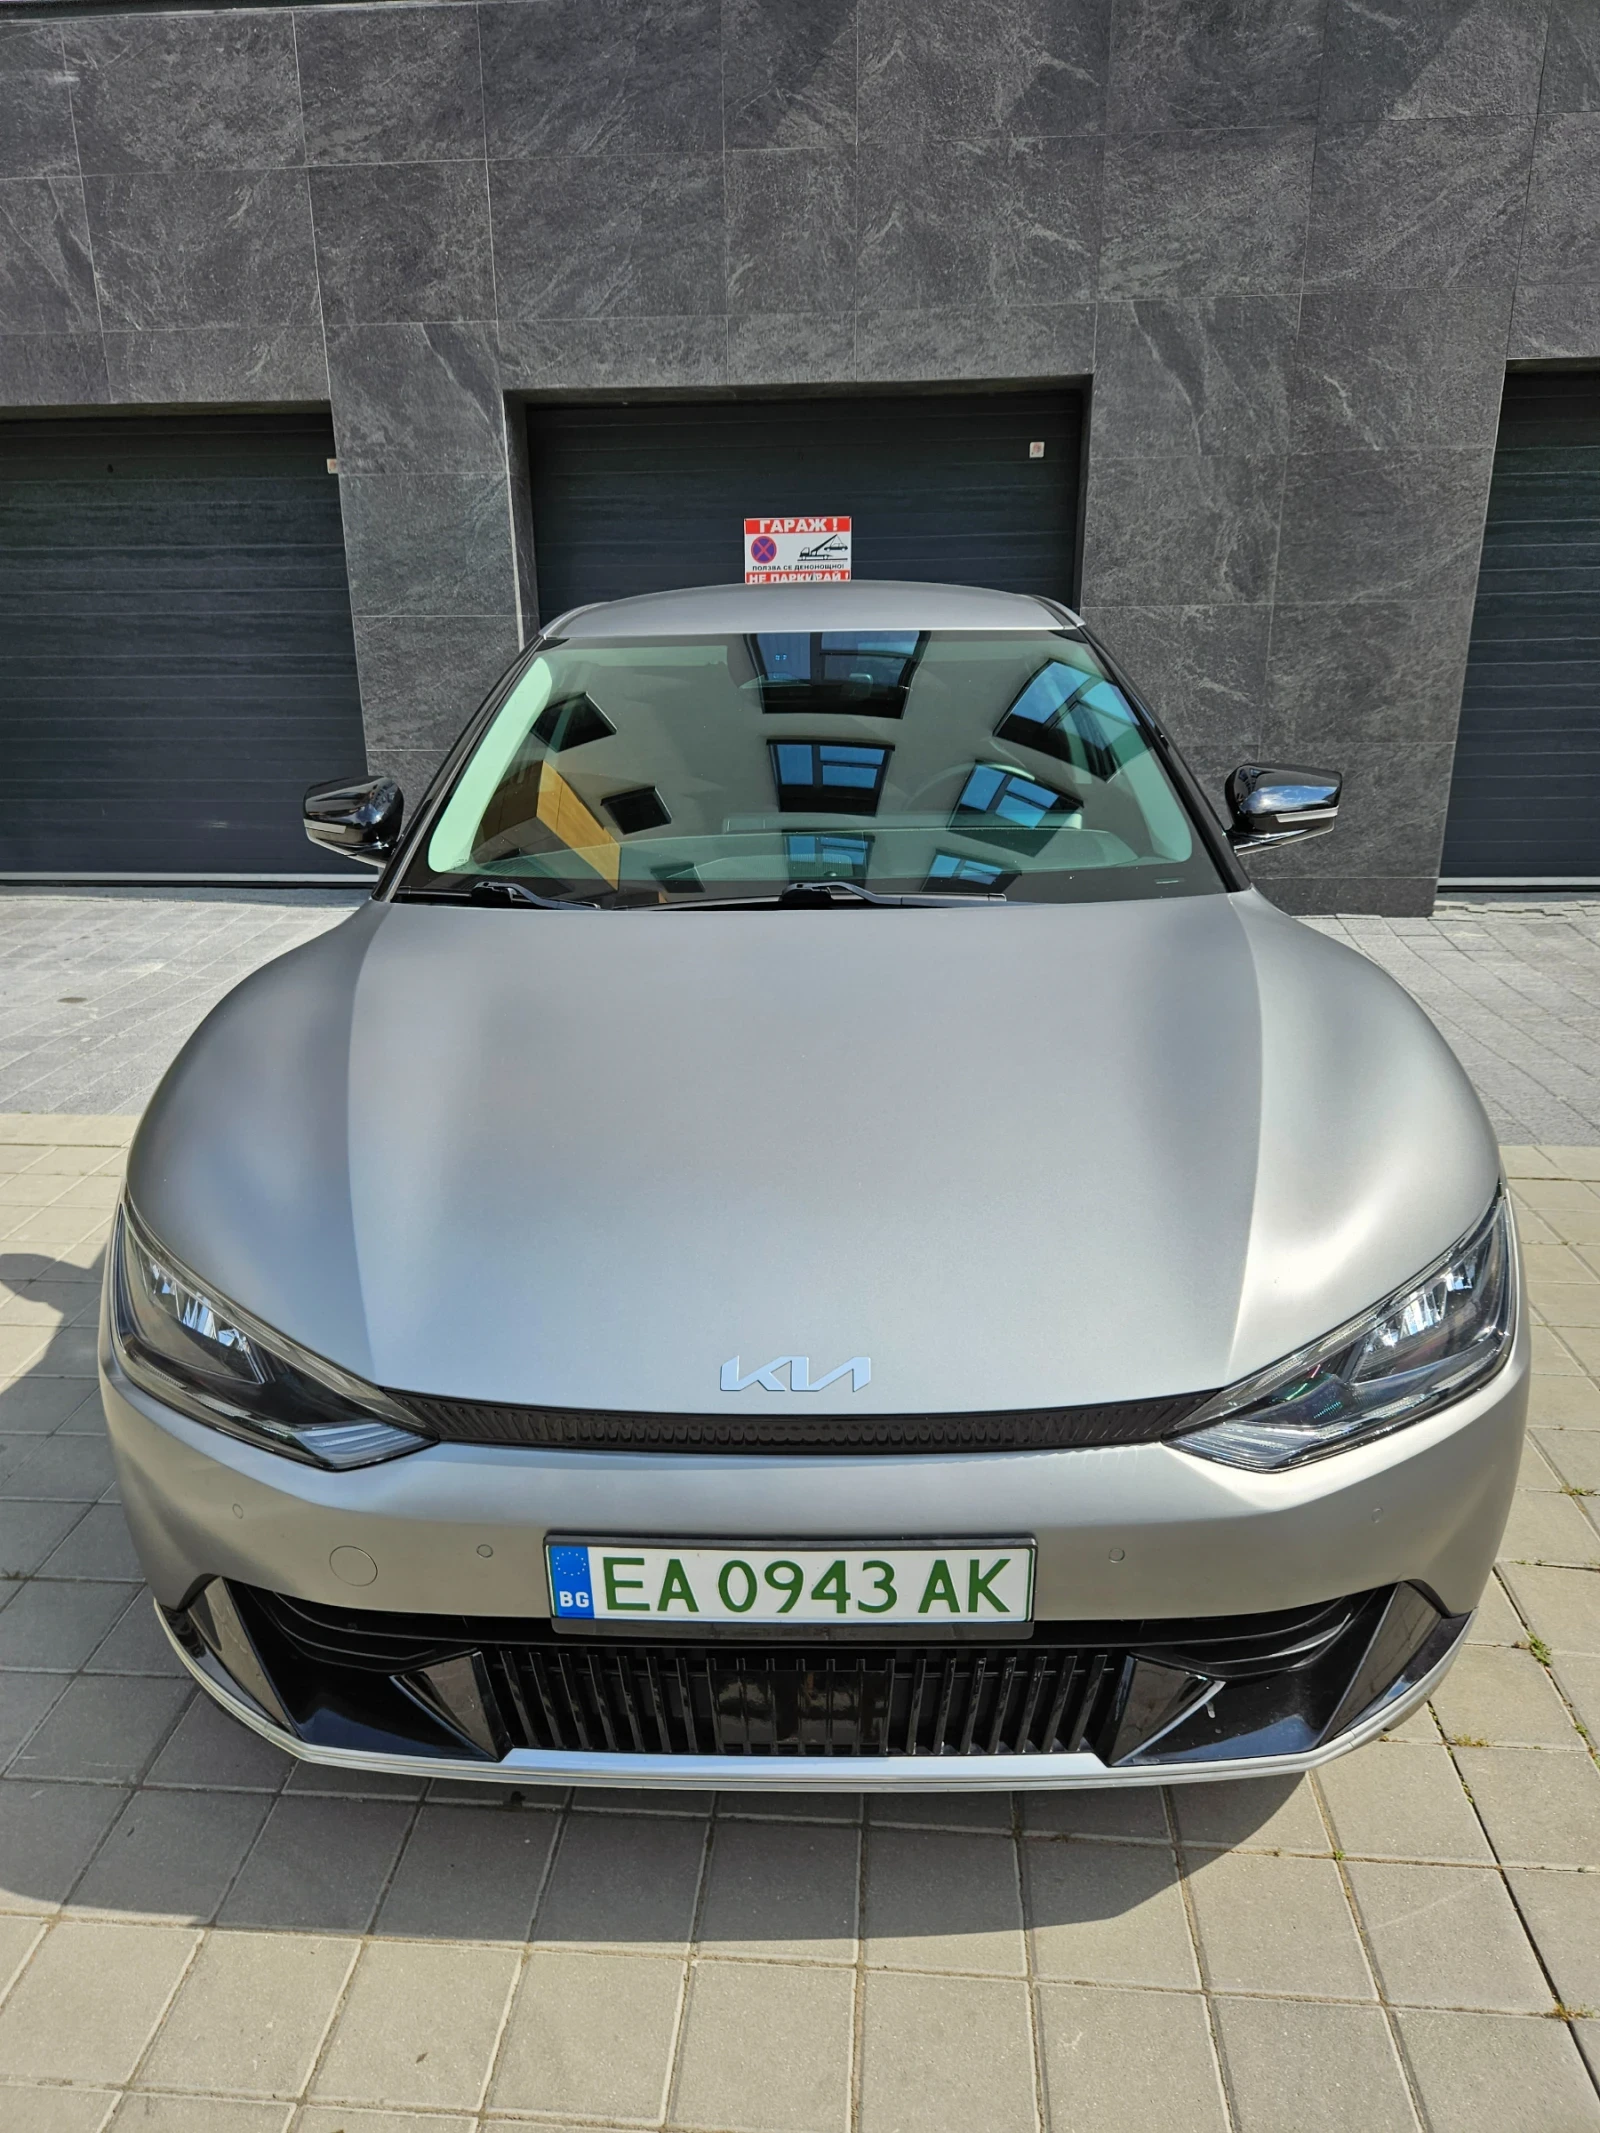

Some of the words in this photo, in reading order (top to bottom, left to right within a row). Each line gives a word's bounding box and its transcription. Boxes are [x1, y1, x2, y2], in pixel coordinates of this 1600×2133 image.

[760, 518, 827, 533] ГАРАЖ
[749, 574, 767, 583] НЕ
[771, 571, 841, 582] ПАРКИРАЙ
[720, 1355, 871, 1392] KIA
[602, 1556, 699, 1613] EA
[717, 1559, 898, 1614] 0943
[917, 1558, 1011, 1613] AK
[559, 1590, 590, 1608] BG
